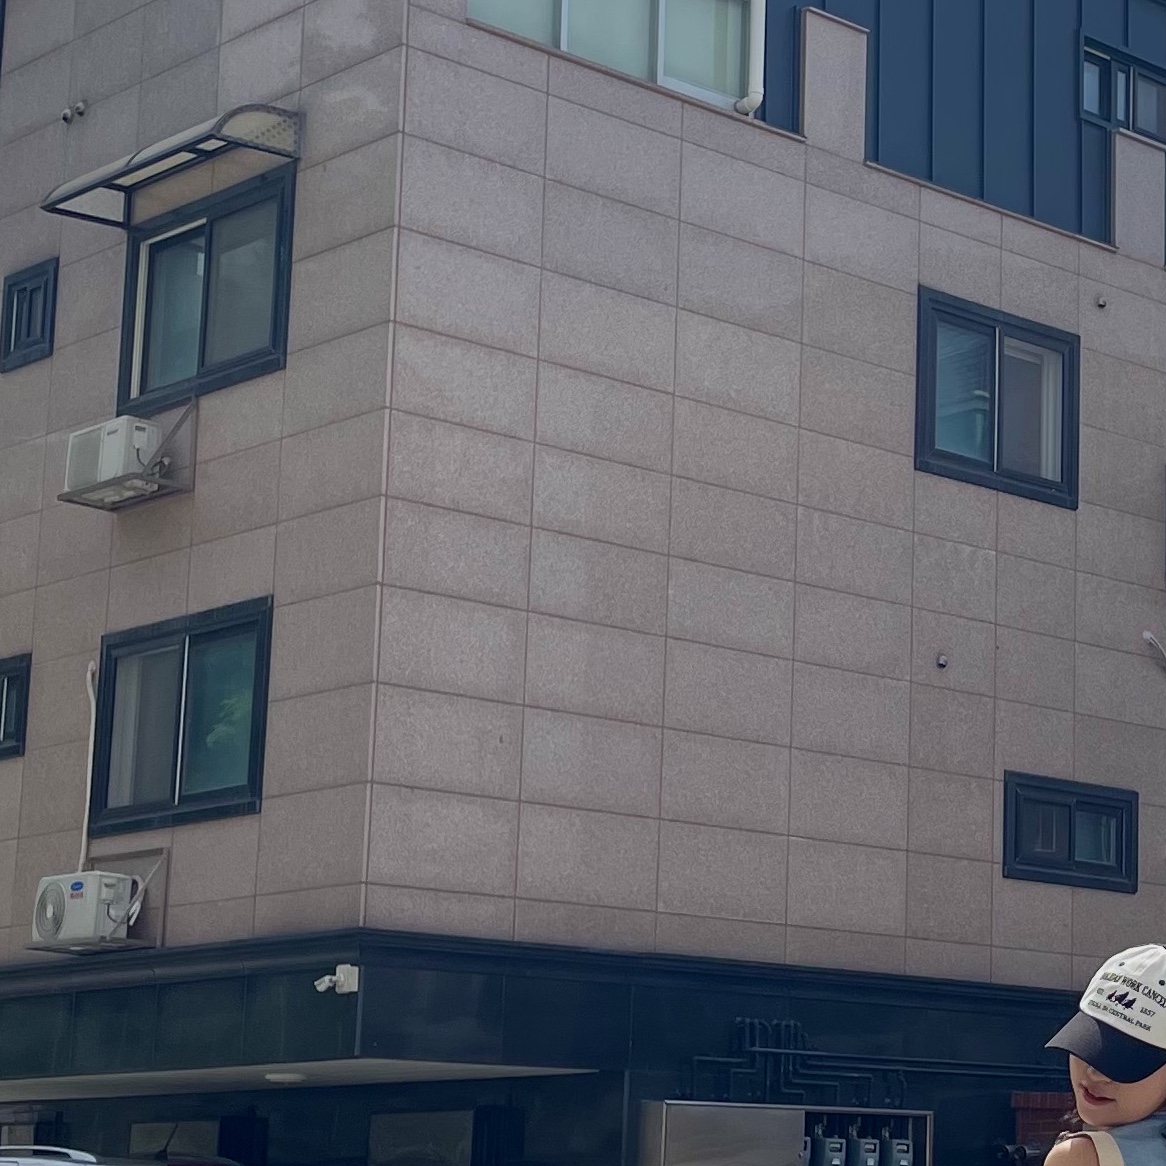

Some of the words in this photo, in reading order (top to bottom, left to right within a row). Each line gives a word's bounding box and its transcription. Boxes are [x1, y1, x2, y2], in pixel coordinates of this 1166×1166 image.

[1121, 975, 1143, 992] WORK
[1141, 986, 1166, 1008] CANCEL
[1109, 1008, 1135, 1024] CENTRAL
[1135, 1020, 1151, 1031] PARK
